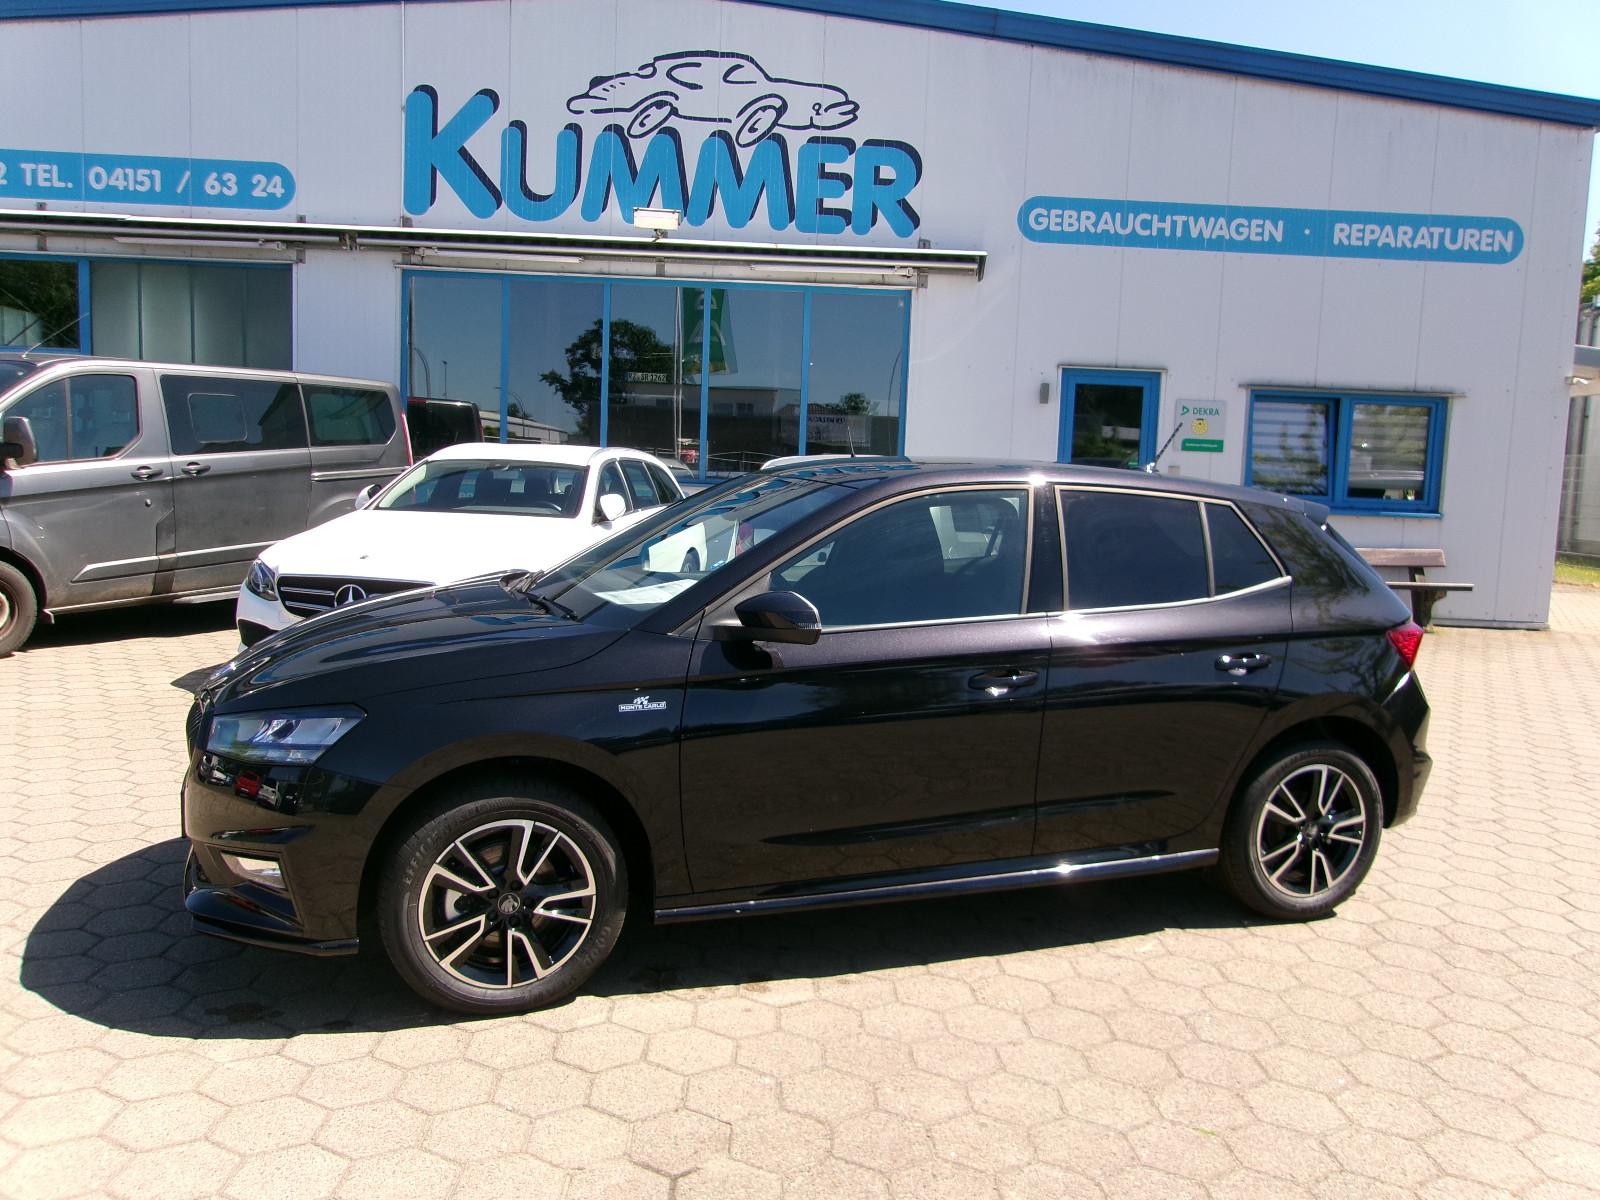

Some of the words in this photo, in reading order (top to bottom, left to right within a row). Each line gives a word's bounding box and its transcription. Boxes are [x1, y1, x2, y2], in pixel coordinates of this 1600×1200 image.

[20, 163, 73, 189] TEL.
[88, 166, 161, 193] 04151
[176, 171, 191, 193] /
[204, 172, 238, 196] 63
[251, 175, 285, 198] 24
[402, 84, 922, 238] KUMMER
[1028, 207, 1284, 243] GEBRAUCHTWAGEN
[1333, 222, 1514, 253] REPARATUREN
[1192, 407, 1220, 416] DEKRA
